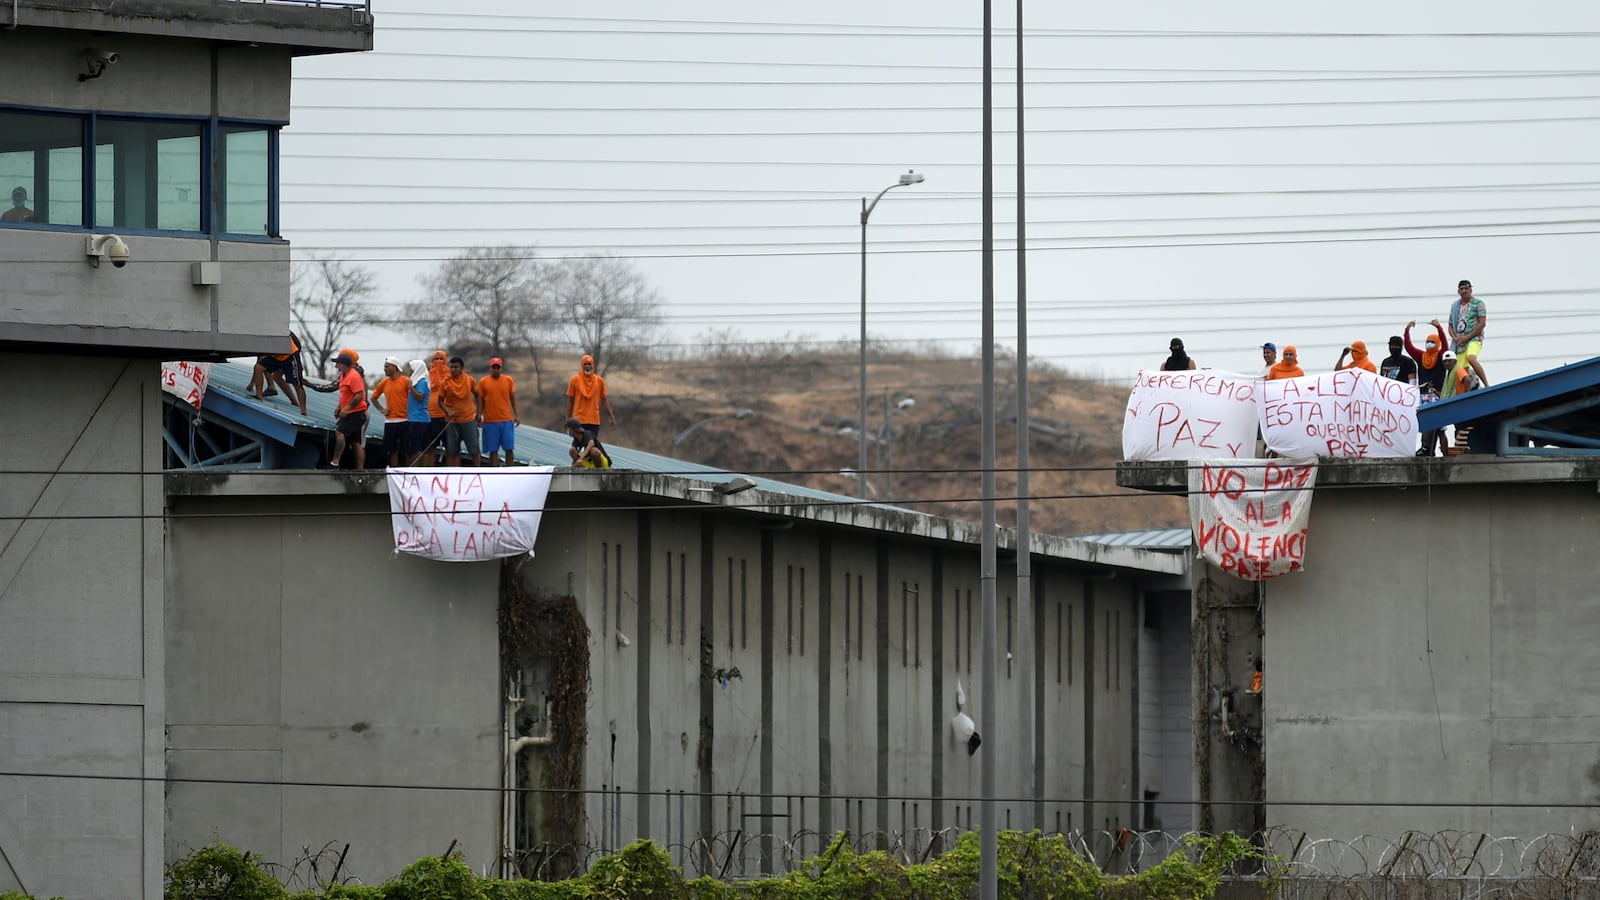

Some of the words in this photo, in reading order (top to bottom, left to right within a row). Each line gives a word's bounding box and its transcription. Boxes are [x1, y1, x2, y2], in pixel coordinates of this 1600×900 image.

[1372, 377, 1416, 407] NOS
[1149, 402, 1221, 452] PAZ
[1265, 401, 1324, 428] ESTA
[1334, 400, 1411, 434] MATANDO
[1326, 439, 1368, 458] PAZ
[1202, 463, 1246, 499] NO
[1264, 462, 1314, 493] PAZ
[402, 495, 516, 527] VARELA
[1220, 552, 1280, 579] PAZ
